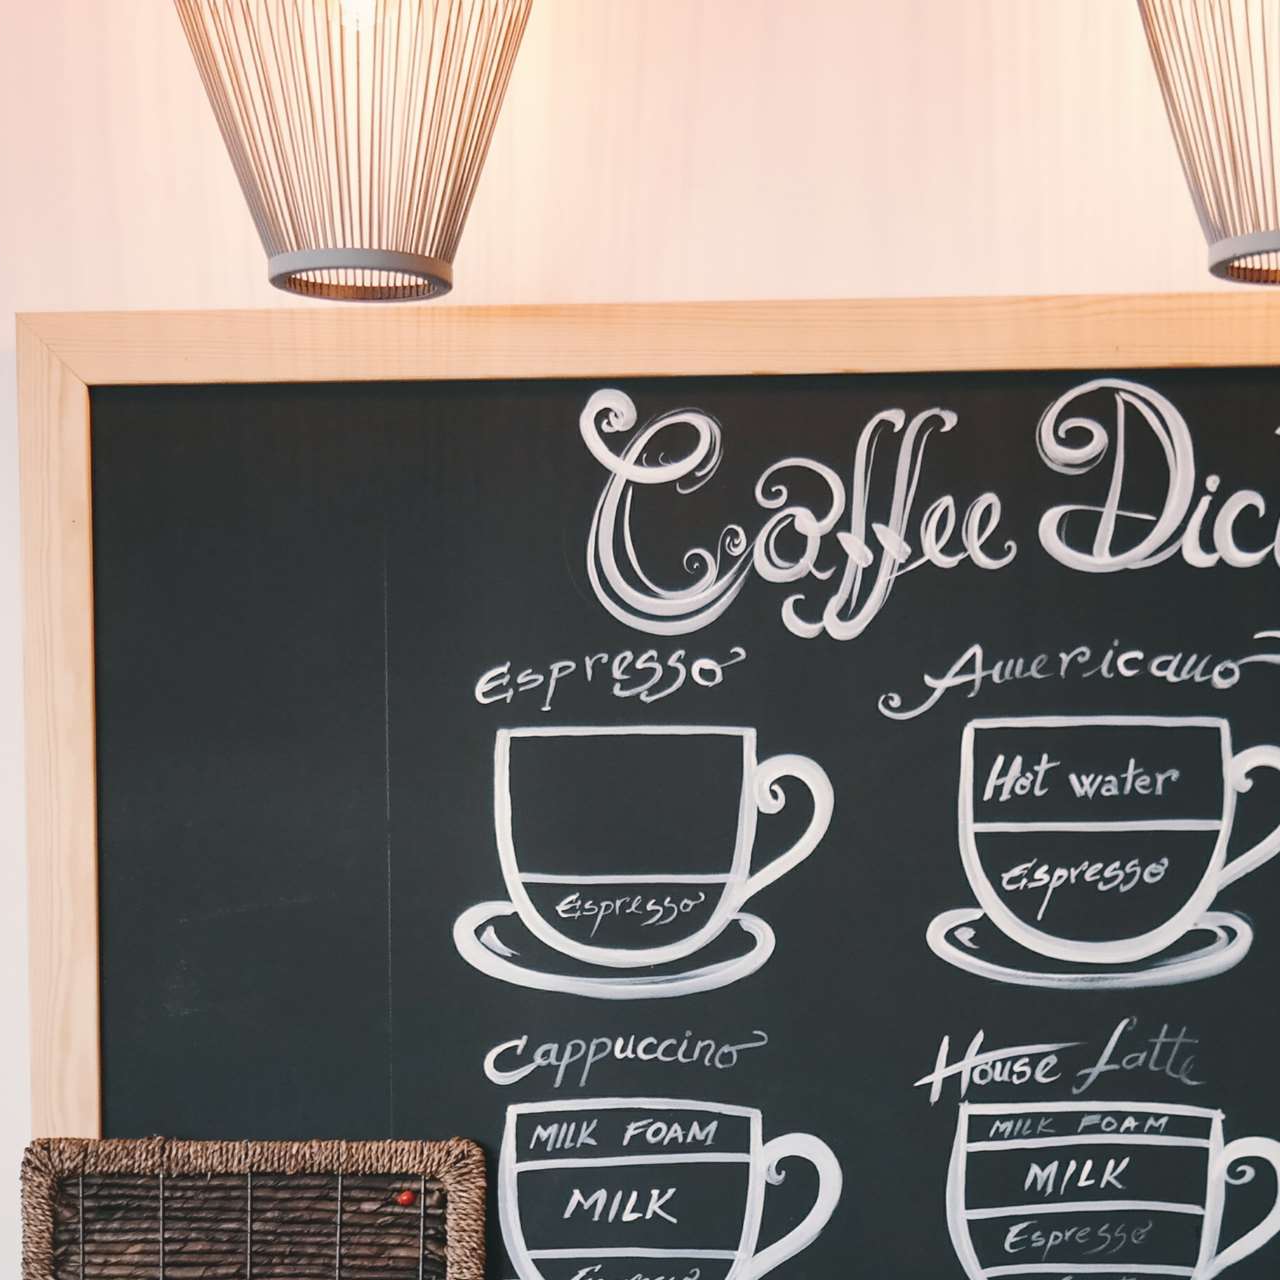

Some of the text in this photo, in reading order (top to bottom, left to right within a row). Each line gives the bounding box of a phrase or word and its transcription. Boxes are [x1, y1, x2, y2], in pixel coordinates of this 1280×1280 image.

[579, 388, 1017, 640] Coffee
[474, 646, 747, 711] Espresso
[983, 753, 1180, 802] Hot water
[1001, 857, 1169, 921] Espresso
[555, 891, 706, 936] Espresso
[483, 1029, 768, 1087] Cappuccino
[913, 1016, 1207, 1106] House Latte
[530, 1118, 719, 1151] MILK FOAM
[989, 1113, 1169, 1139] MILK FOAM
[1024, 1156, 1131, 1198] MILK
[562, 1187, 678, 1224] MILK
[1003, 1219, 1153, 1261] Espresso
